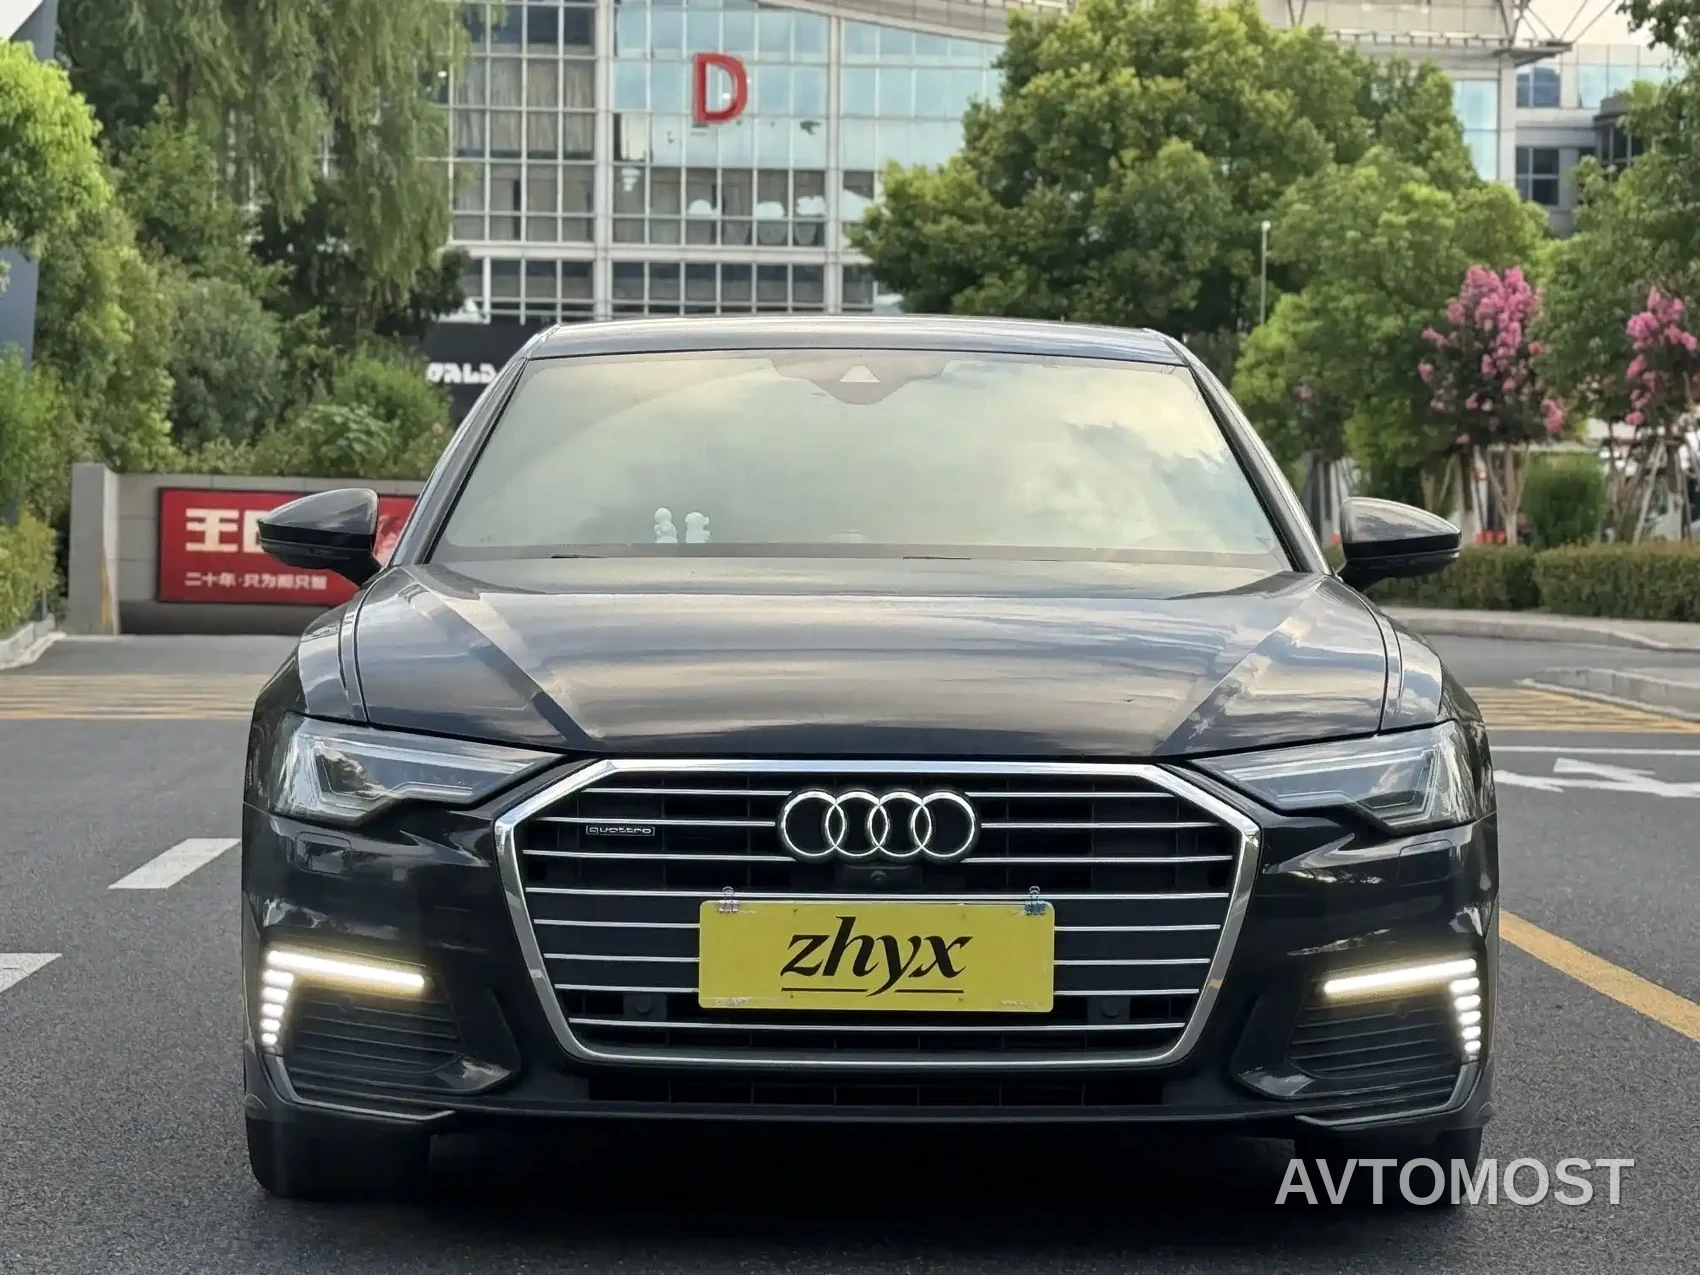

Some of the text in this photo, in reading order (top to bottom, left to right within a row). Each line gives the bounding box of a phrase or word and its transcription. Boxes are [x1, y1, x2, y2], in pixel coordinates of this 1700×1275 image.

[692, 52, 748, 125] D
[185, 508, 267, 554] 王
[780, 916, 973, 997] zhyx
